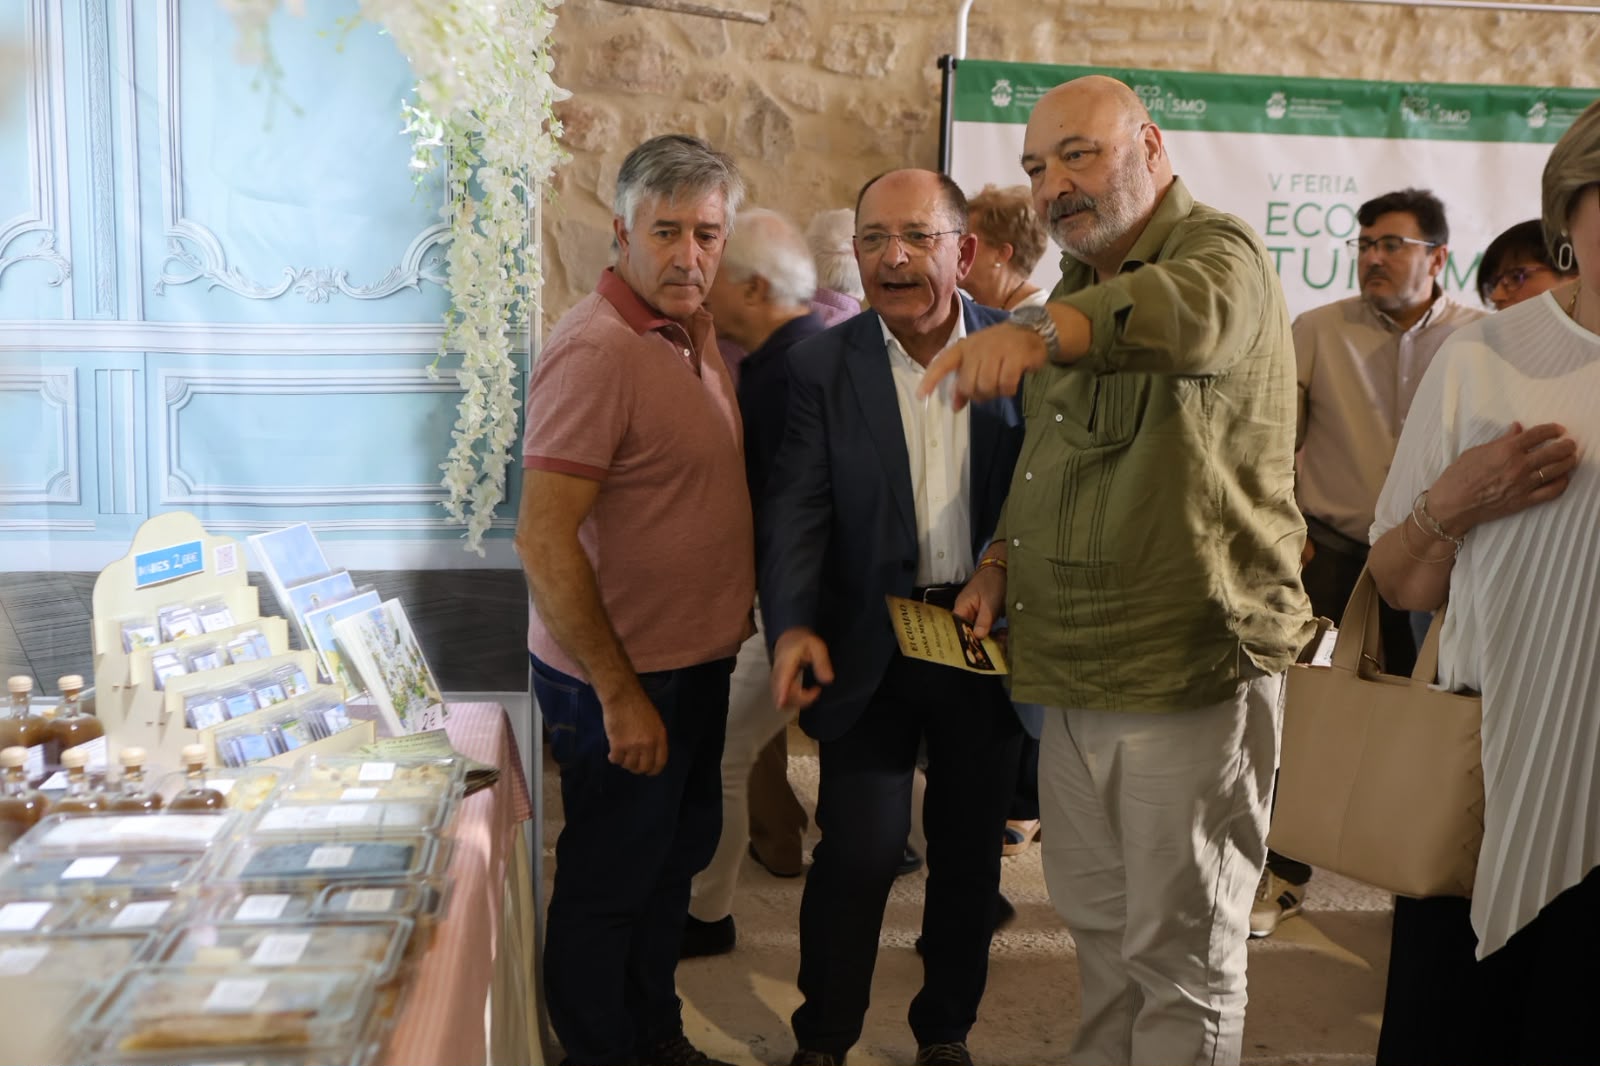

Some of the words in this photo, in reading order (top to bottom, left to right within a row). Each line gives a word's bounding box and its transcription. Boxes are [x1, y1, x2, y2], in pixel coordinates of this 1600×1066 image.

[1267, 173, 1283, 192] V
[1290, 174, 1359, 194] FERIA
[1265, 202, 1357, 239] ECO
